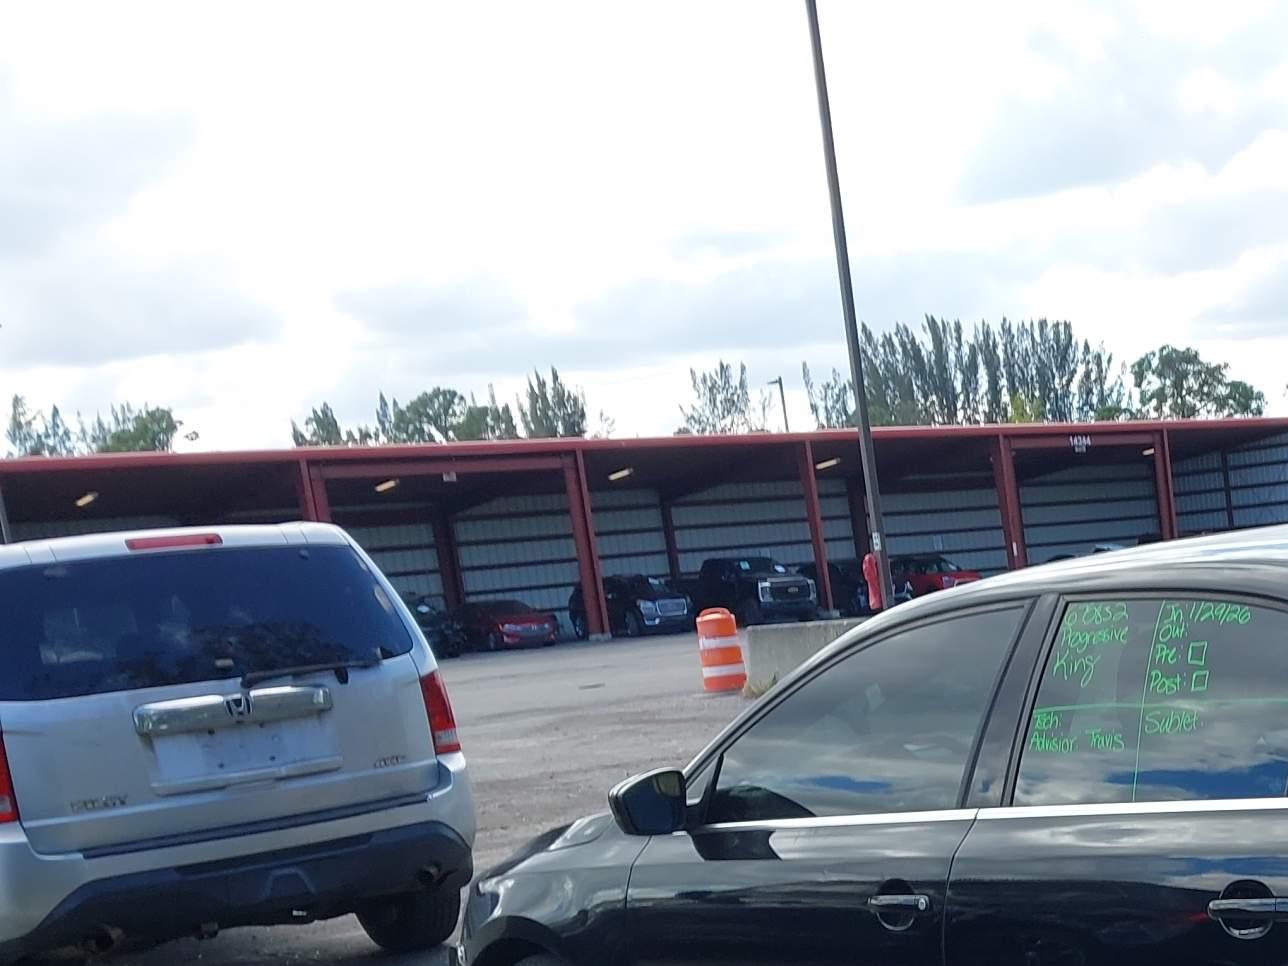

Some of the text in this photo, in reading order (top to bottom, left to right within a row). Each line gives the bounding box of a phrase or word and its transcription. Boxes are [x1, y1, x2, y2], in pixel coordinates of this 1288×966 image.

[1156, 643, 1184, 664] Pre:
[1053, 650, 1100, 688] King
[1150, 670, 1186, 695] Post:
[1086, 728, 1125, 751] Travis
